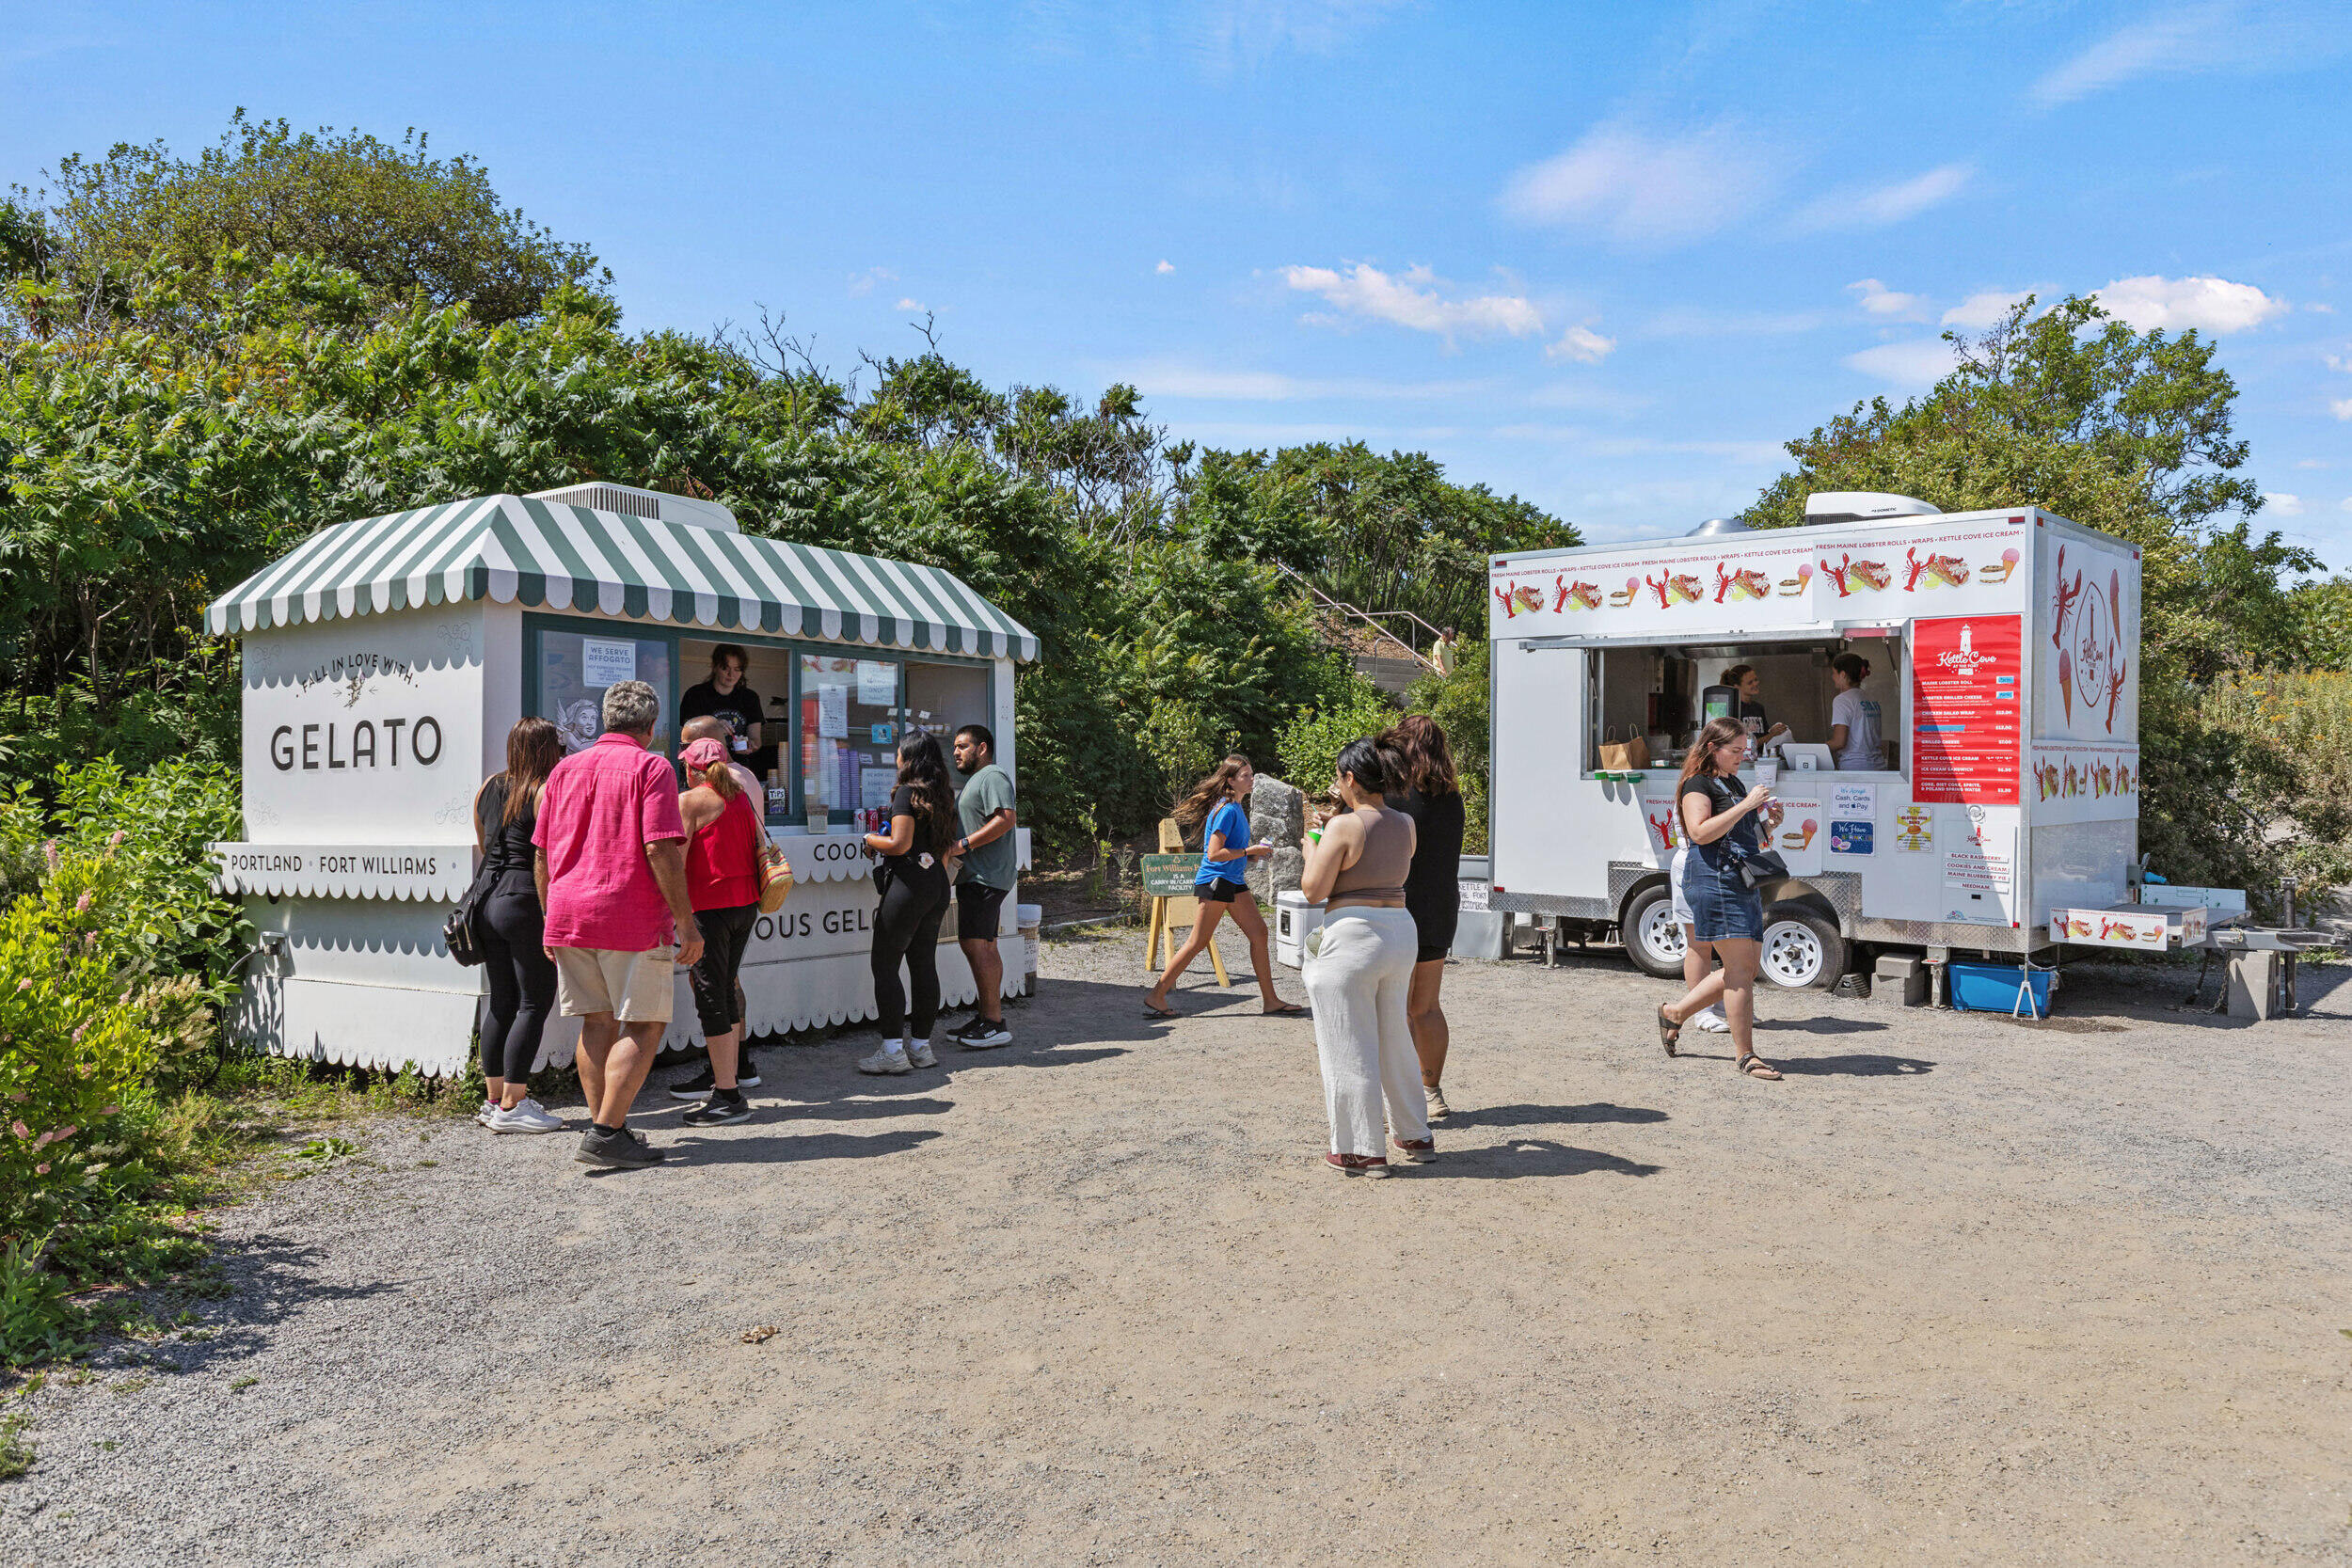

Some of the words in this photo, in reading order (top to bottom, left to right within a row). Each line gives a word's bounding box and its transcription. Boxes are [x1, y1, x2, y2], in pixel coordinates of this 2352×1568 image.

[1859, 540, 1886, 548] LOBSTER
[588, 655, 631, 664] AFFOGATO
[1936, 651, 1968, 667] Kettle
[1969, 650, 1997, 664] Cove
[302, 665, 328, 693] FALL
[332, 657, 343, 673] IN
[348, 653, 378, 668] LOVE
[384, 657, 414, 685] WITH
[270, 716, 442, 771] GELATO
[1857, 802, 1868, 811] Pay
[1838, 822, 1850, 832] We
[1849, 823, 1867, 835] Have
[231, 854, 302, 872] PORTLAND
[320, 856, 357, 873] FORT
[362, 857, 437, 875] WILLIAMS
[1146, 864, 1161, 873] Fort
[1162, 863, 1193, 873] Williams
